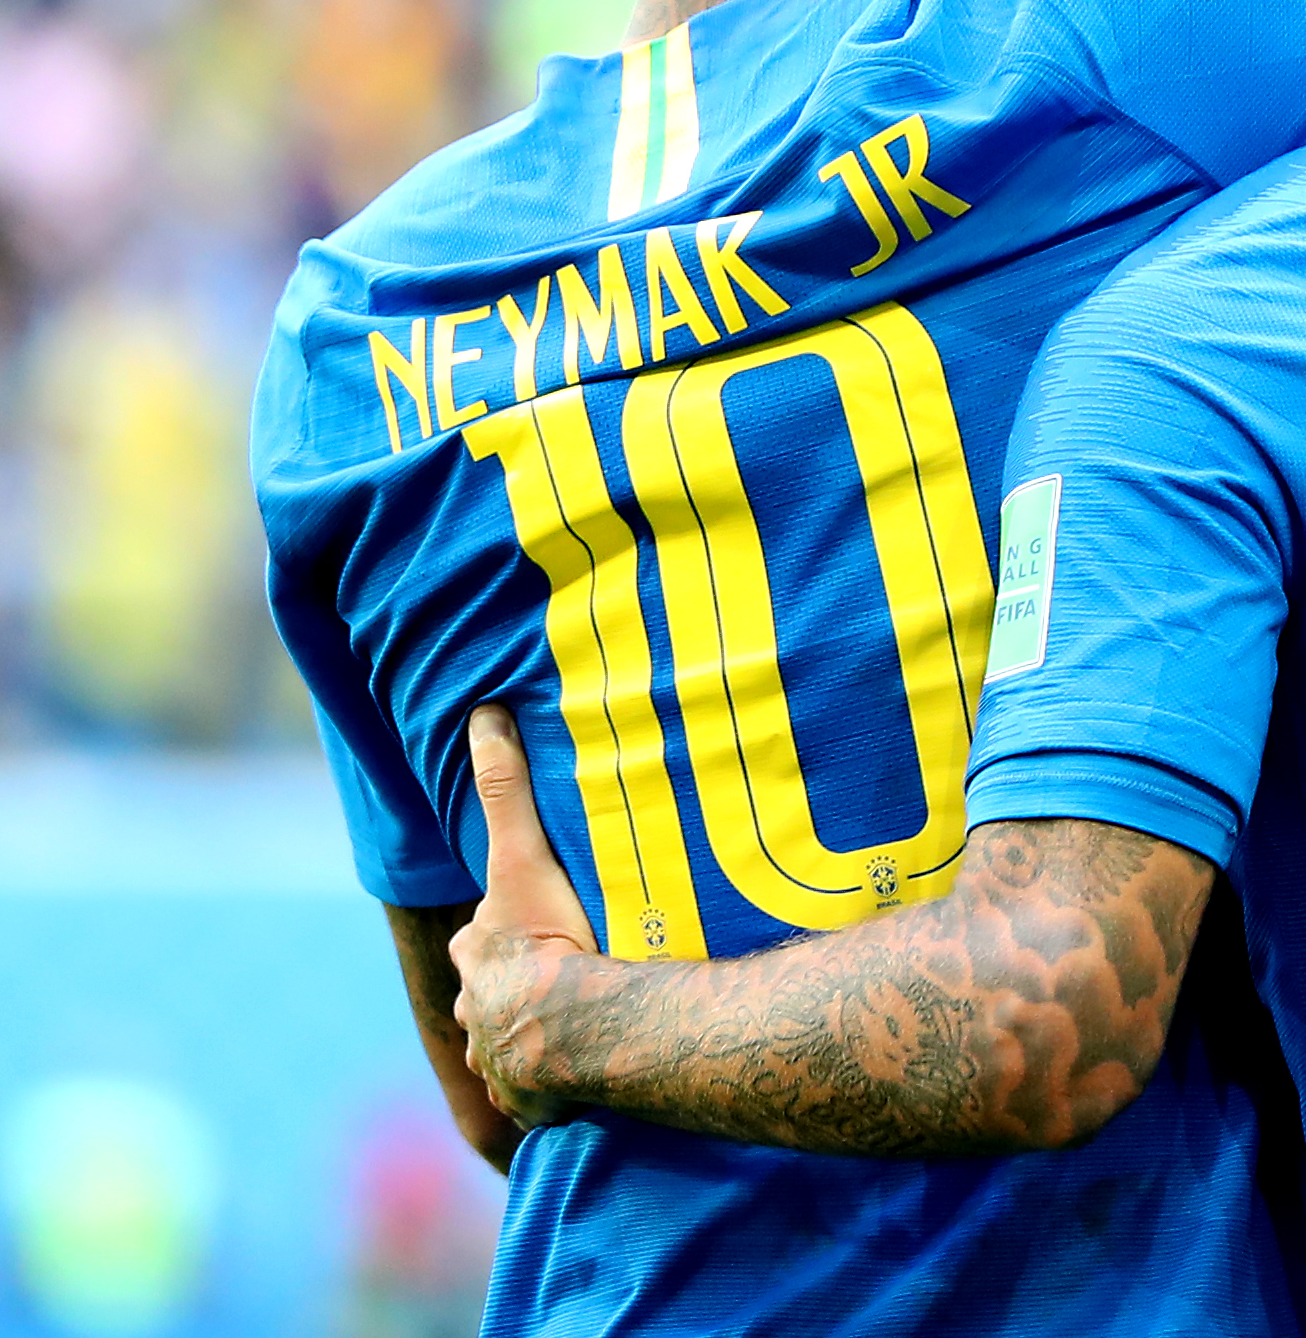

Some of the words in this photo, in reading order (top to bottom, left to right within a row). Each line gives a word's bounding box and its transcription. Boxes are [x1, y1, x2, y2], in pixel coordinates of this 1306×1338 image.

[369, 210, 791, 453] NEYMAR
[819, 113, 972, 276] JR
[461, 303, 995, 962] 10
[997, 599, 1035, 624] FIFA
